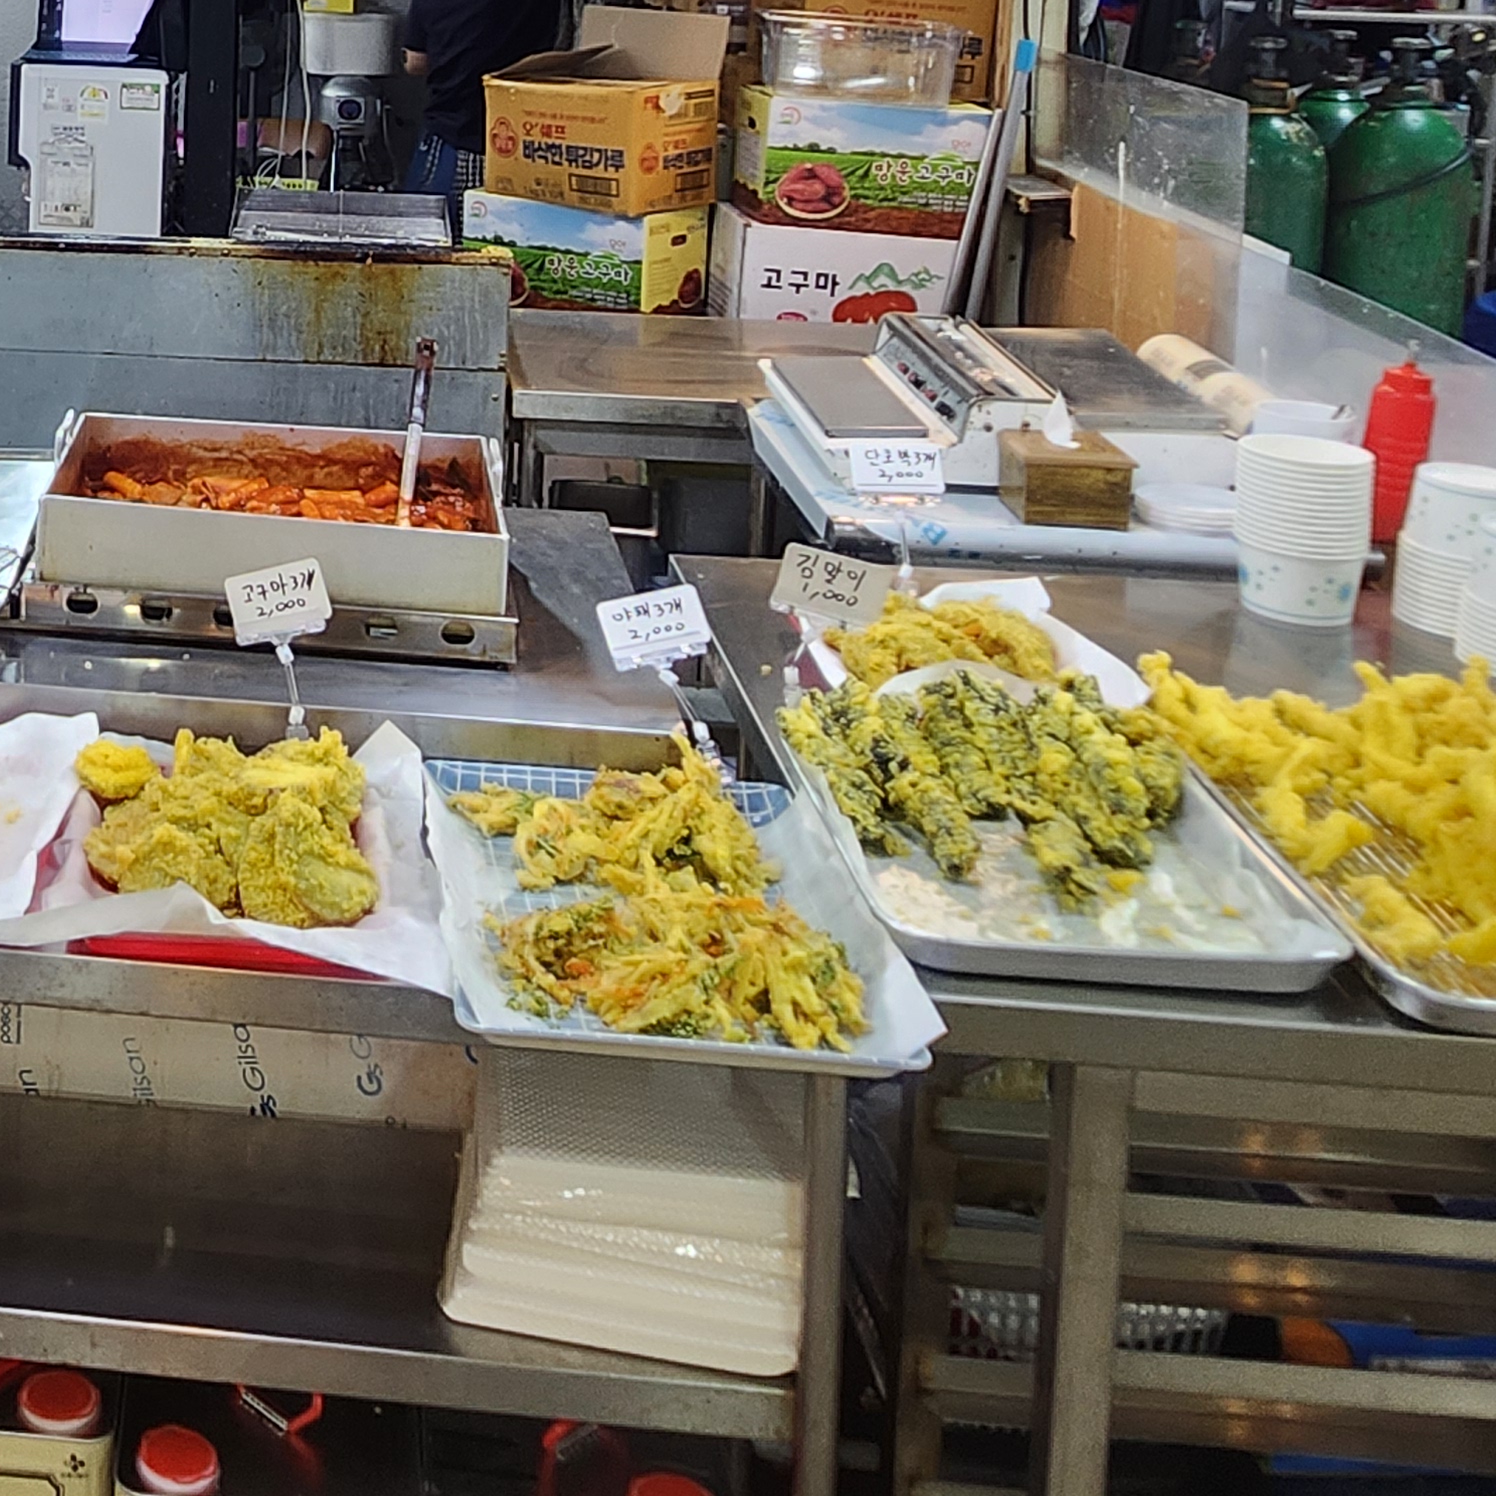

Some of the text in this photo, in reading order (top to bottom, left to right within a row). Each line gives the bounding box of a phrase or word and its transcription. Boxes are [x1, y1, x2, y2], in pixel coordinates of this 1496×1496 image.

[522, 138, 626, 173] 바삭한 튀김가루
[760, 267, 841, 298] 고구마
[878, 468, 924, 483] 2,000
[255, 598, 306, 618] 2,000
[802, 582, 859, 607] 1,000
[627, 622, 685, 641] 2,000
[121, 1036, 157, 1108] ilsan
[232, 1024, 266, 1092] Gilsa
